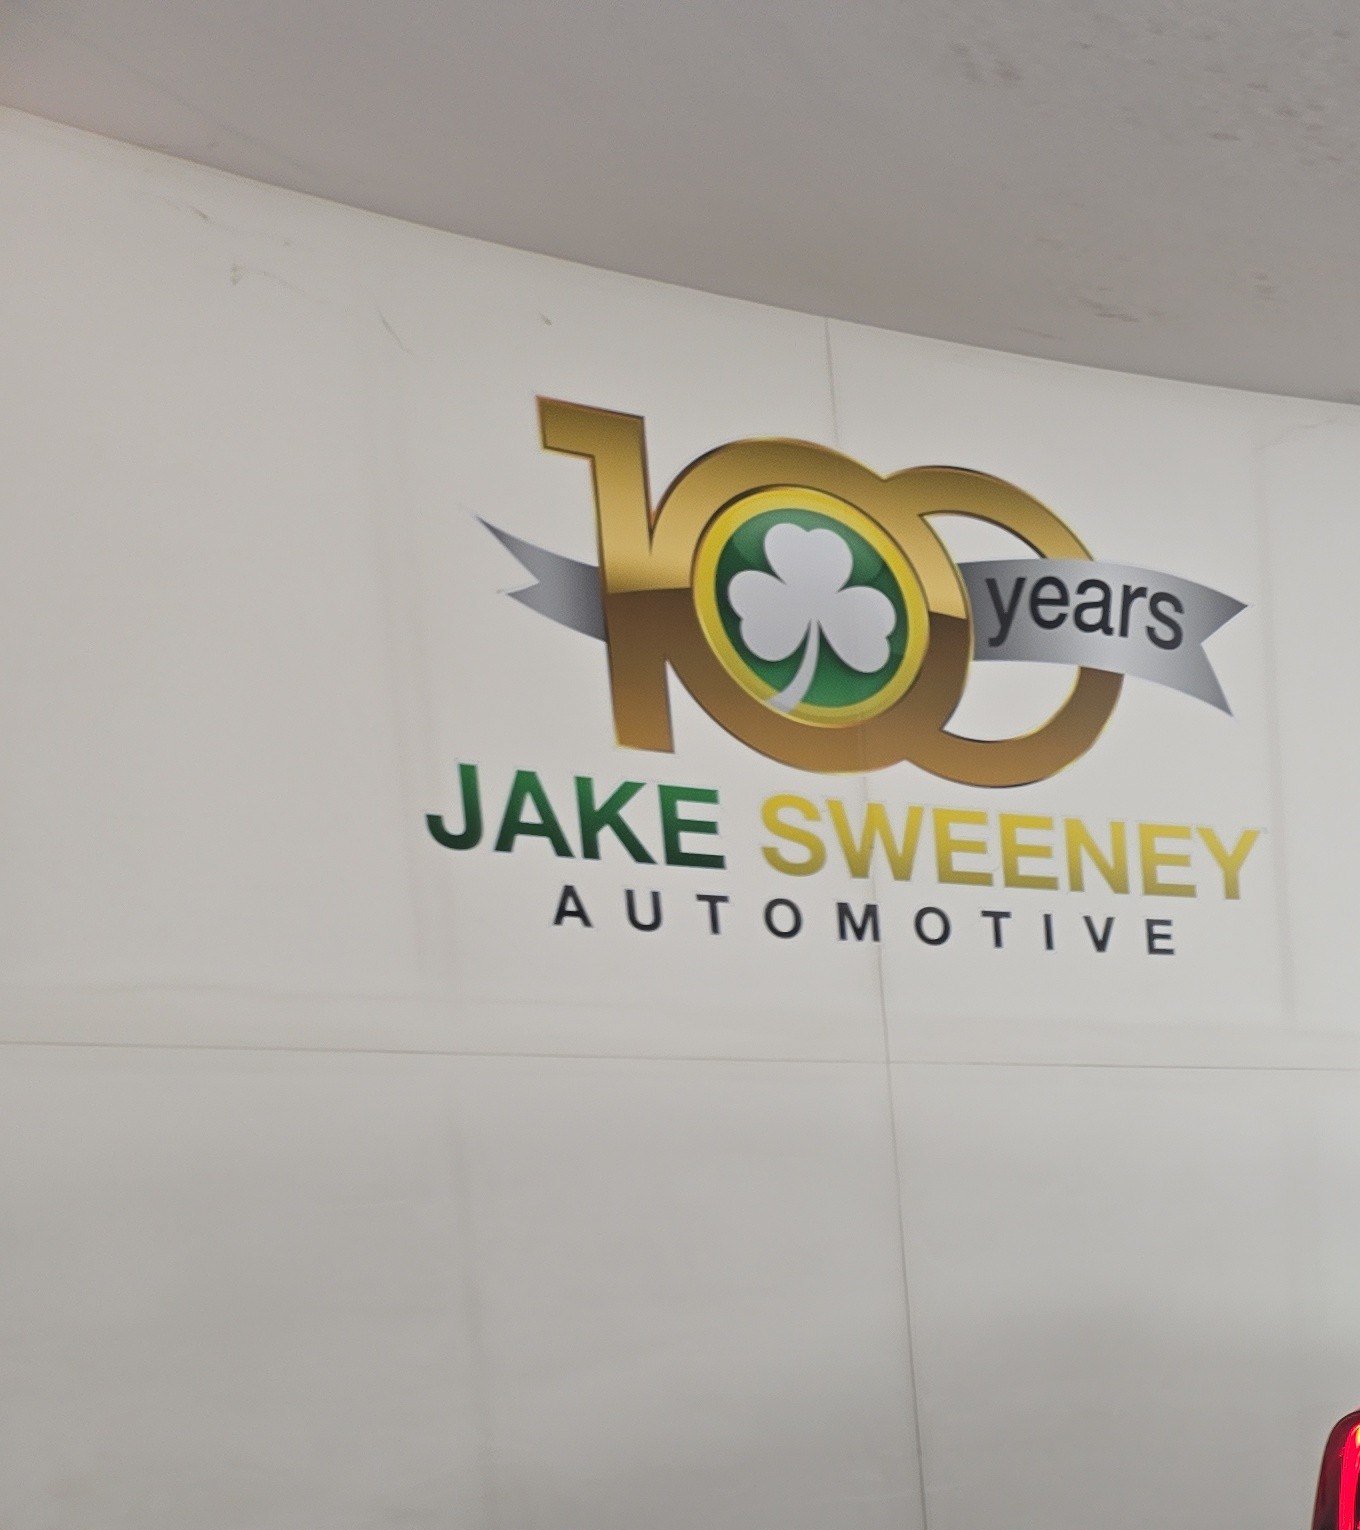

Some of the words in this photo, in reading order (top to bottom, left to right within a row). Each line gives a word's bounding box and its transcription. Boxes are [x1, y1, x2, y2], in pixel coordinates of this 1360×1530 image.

[984, 572, 1186, 651] years
[426, 762, 727, 870] JAKE
[759, 793, 1261, 900] SWEENEY
[552, 884, 1178, 957] AUTOMOTIVE
